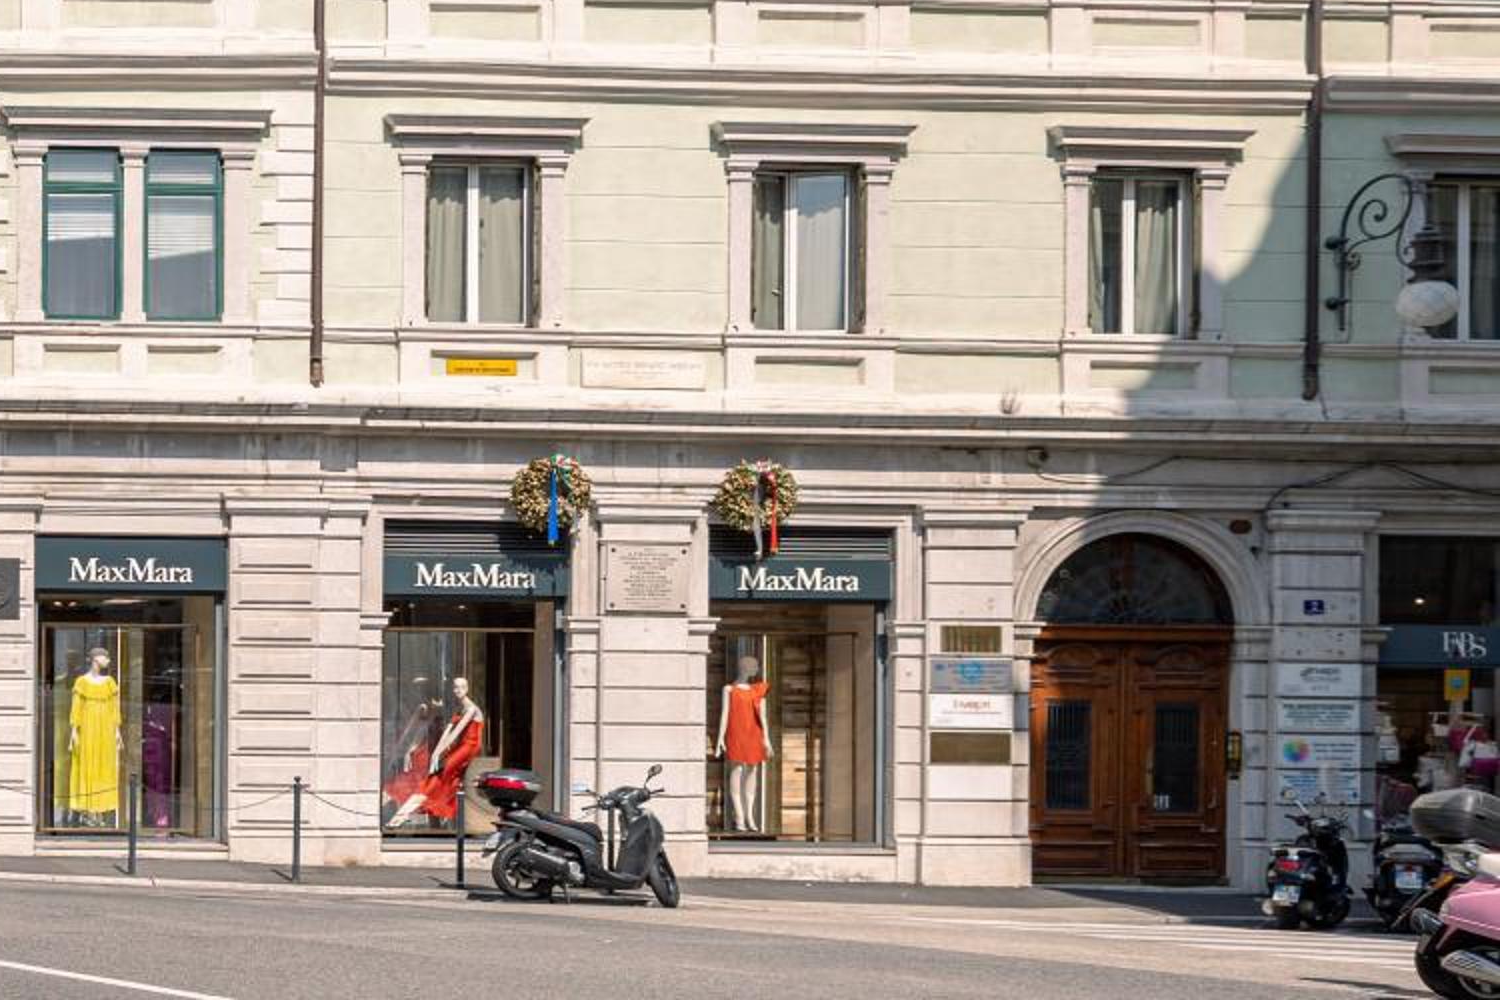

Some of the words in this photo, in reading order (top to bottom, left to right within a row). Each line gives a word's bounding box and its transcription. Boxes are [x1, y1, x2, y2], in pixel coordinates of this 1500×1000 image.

[69, 557, 193, 584] MaxMara
[414, 562, 536, 590] MaxMara
[738, 566, 859, 593] MaxMara
